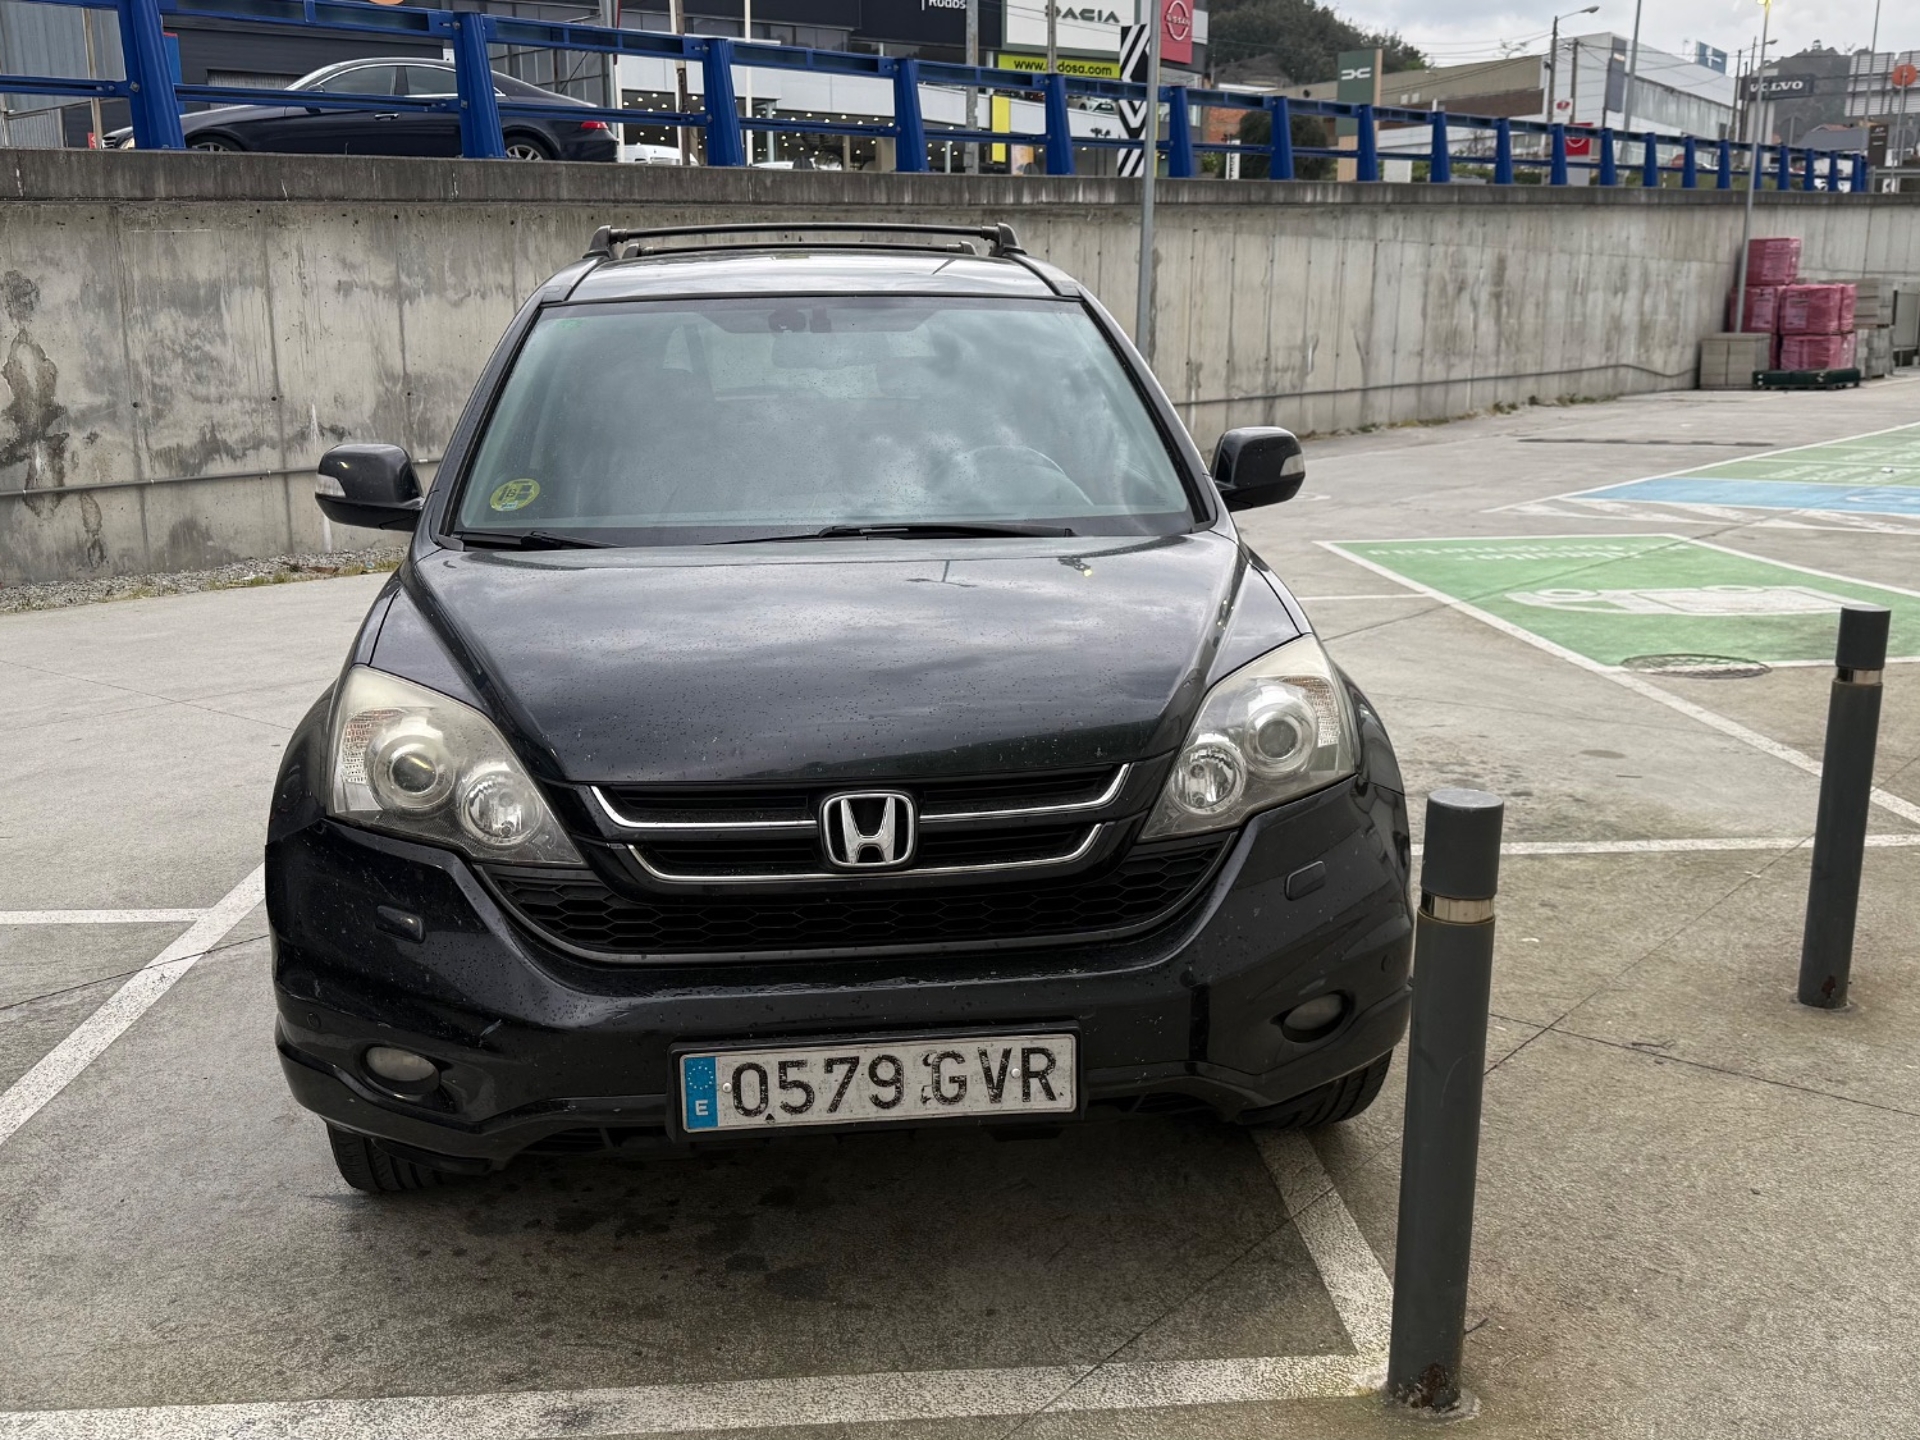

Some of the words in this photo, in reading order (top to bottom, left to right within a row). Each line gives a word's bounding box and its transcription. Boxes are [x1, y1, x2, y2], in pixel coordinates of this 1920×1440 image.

[1014, 59, 1112, 77] www.dosa.com
[731, 1054, 905, 1117] 0579
[931, 1046, 1058, 1106] GVR
[695, 1100, 709, 1116] E
